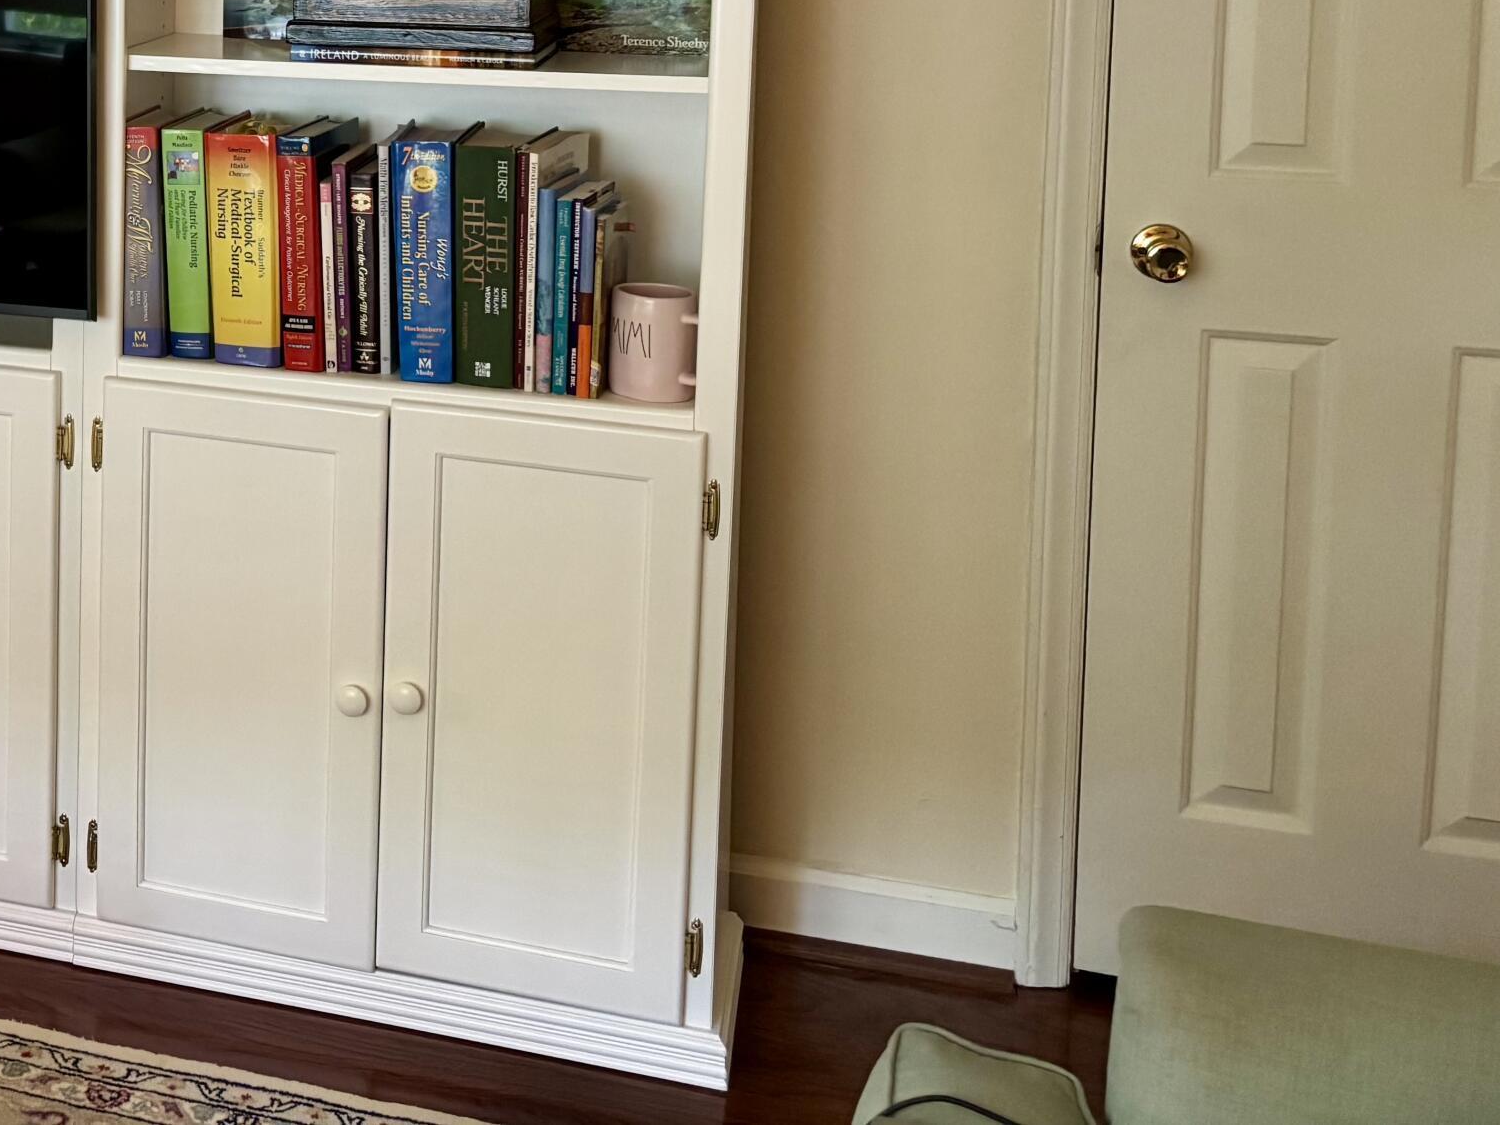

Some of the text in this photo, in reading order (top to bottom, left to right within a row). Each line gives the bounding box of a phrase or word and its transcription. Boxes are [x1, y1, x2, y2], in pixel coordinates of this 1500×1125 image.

[309, 49, 360, 60] IRELAND
[621, 34, 709, 53] Terence Sheehy
[126, 145, 152, 218] Maternity
[284, 169, 292, 192] Clinical
[379, 157, 389, 216] Math For Meds
[497, 160, 508, 202] HURST
[188, 190, 199, 268] Pediatric Nursing
[216, 188, 229, 239] Nursing
[243, 189, 256, 265] Textbook of
[283, 192, 292, 235] Management
[294, 162, 308, 260] MEDICAL-SURGICAL
[229, 188, 243, 298] Medical-Surgical
[257, 189, 265, 279] Brunner Suddarth's
[355, 216, 367, 252] Nursing
[462, 197, 485, 291] HEART
[486, 216, 508, 274] THE
[558, 235, 566, 257] Essential
[337, 257, 345, 296] ELECTROLYTES
[400, 195, 414, 320] Infants and Children
[416, 212, 431, 306] Nursing Care of
[430, 238, 449, 280] Wong's
[557, 258, 566, 270] Drug
[296, 264, 308, 311] NURSING
[356, 267, 368, 301] Critically
[358, 314, 368, 336] Adult
[403, 325, 446, 334] Hockenberry
[613, 317, 652, 359] MIMI
